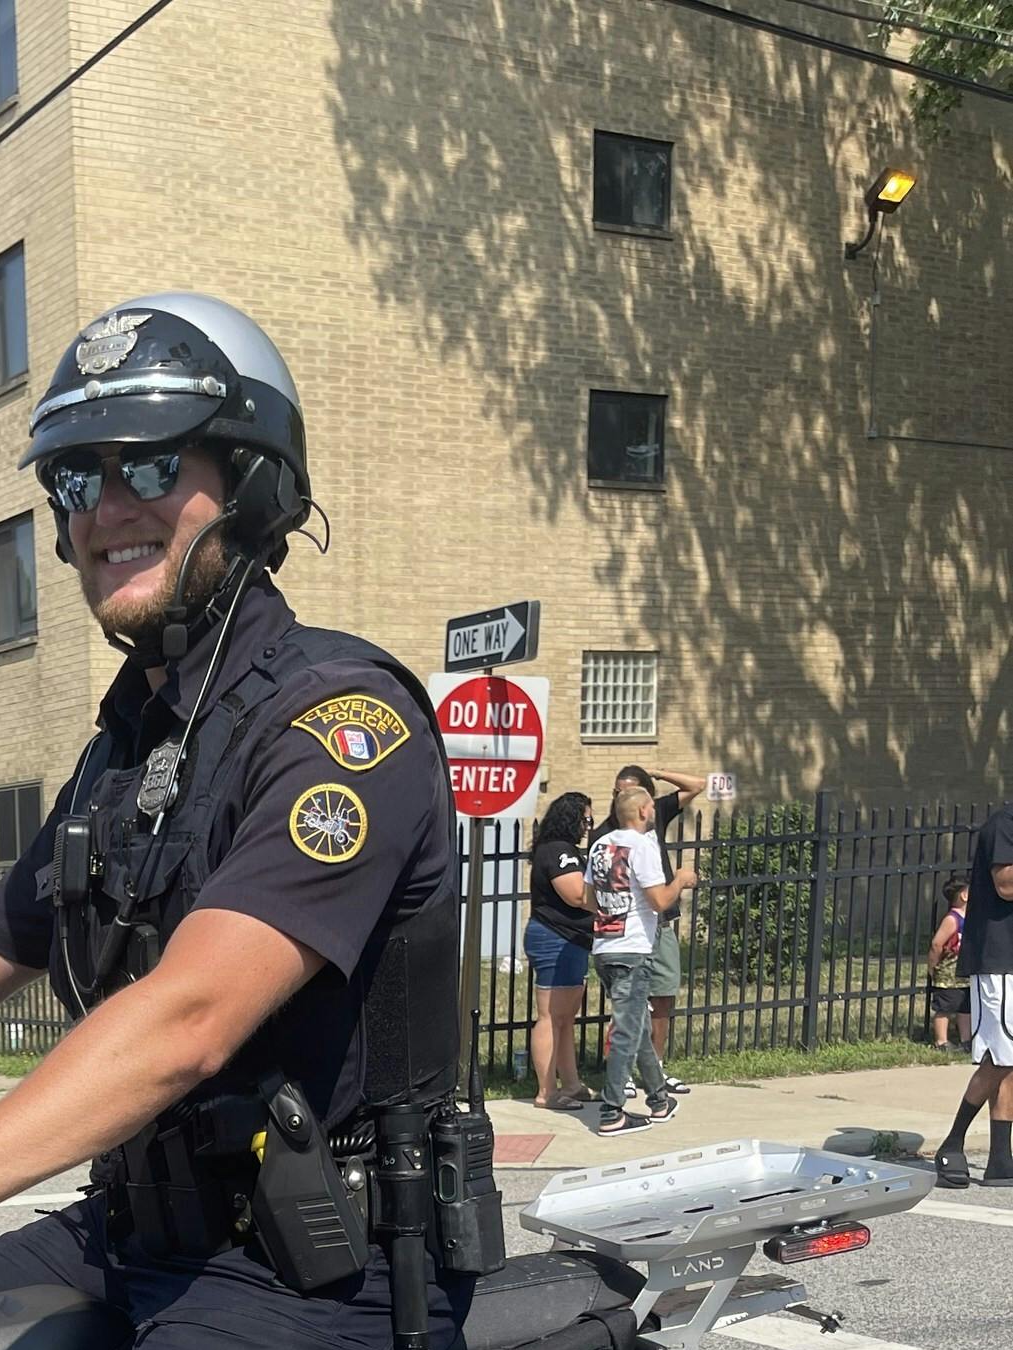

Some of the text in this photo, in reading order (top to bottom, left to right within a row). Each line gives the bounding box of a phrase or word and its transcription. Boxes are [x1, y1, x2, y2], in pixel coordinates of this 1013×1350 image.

[453, 621, 510, 658] ONE WAY
[304, 700, 402, 735] CLEVELAND
[321, 710, 389, 736] POLICE
[449, 700, 528, 730] DO NOT
[449, 765, 518, 793] ENTER
[711, 775, 734, 791] FDC
[671, 1256, 725, 1278] LAND
